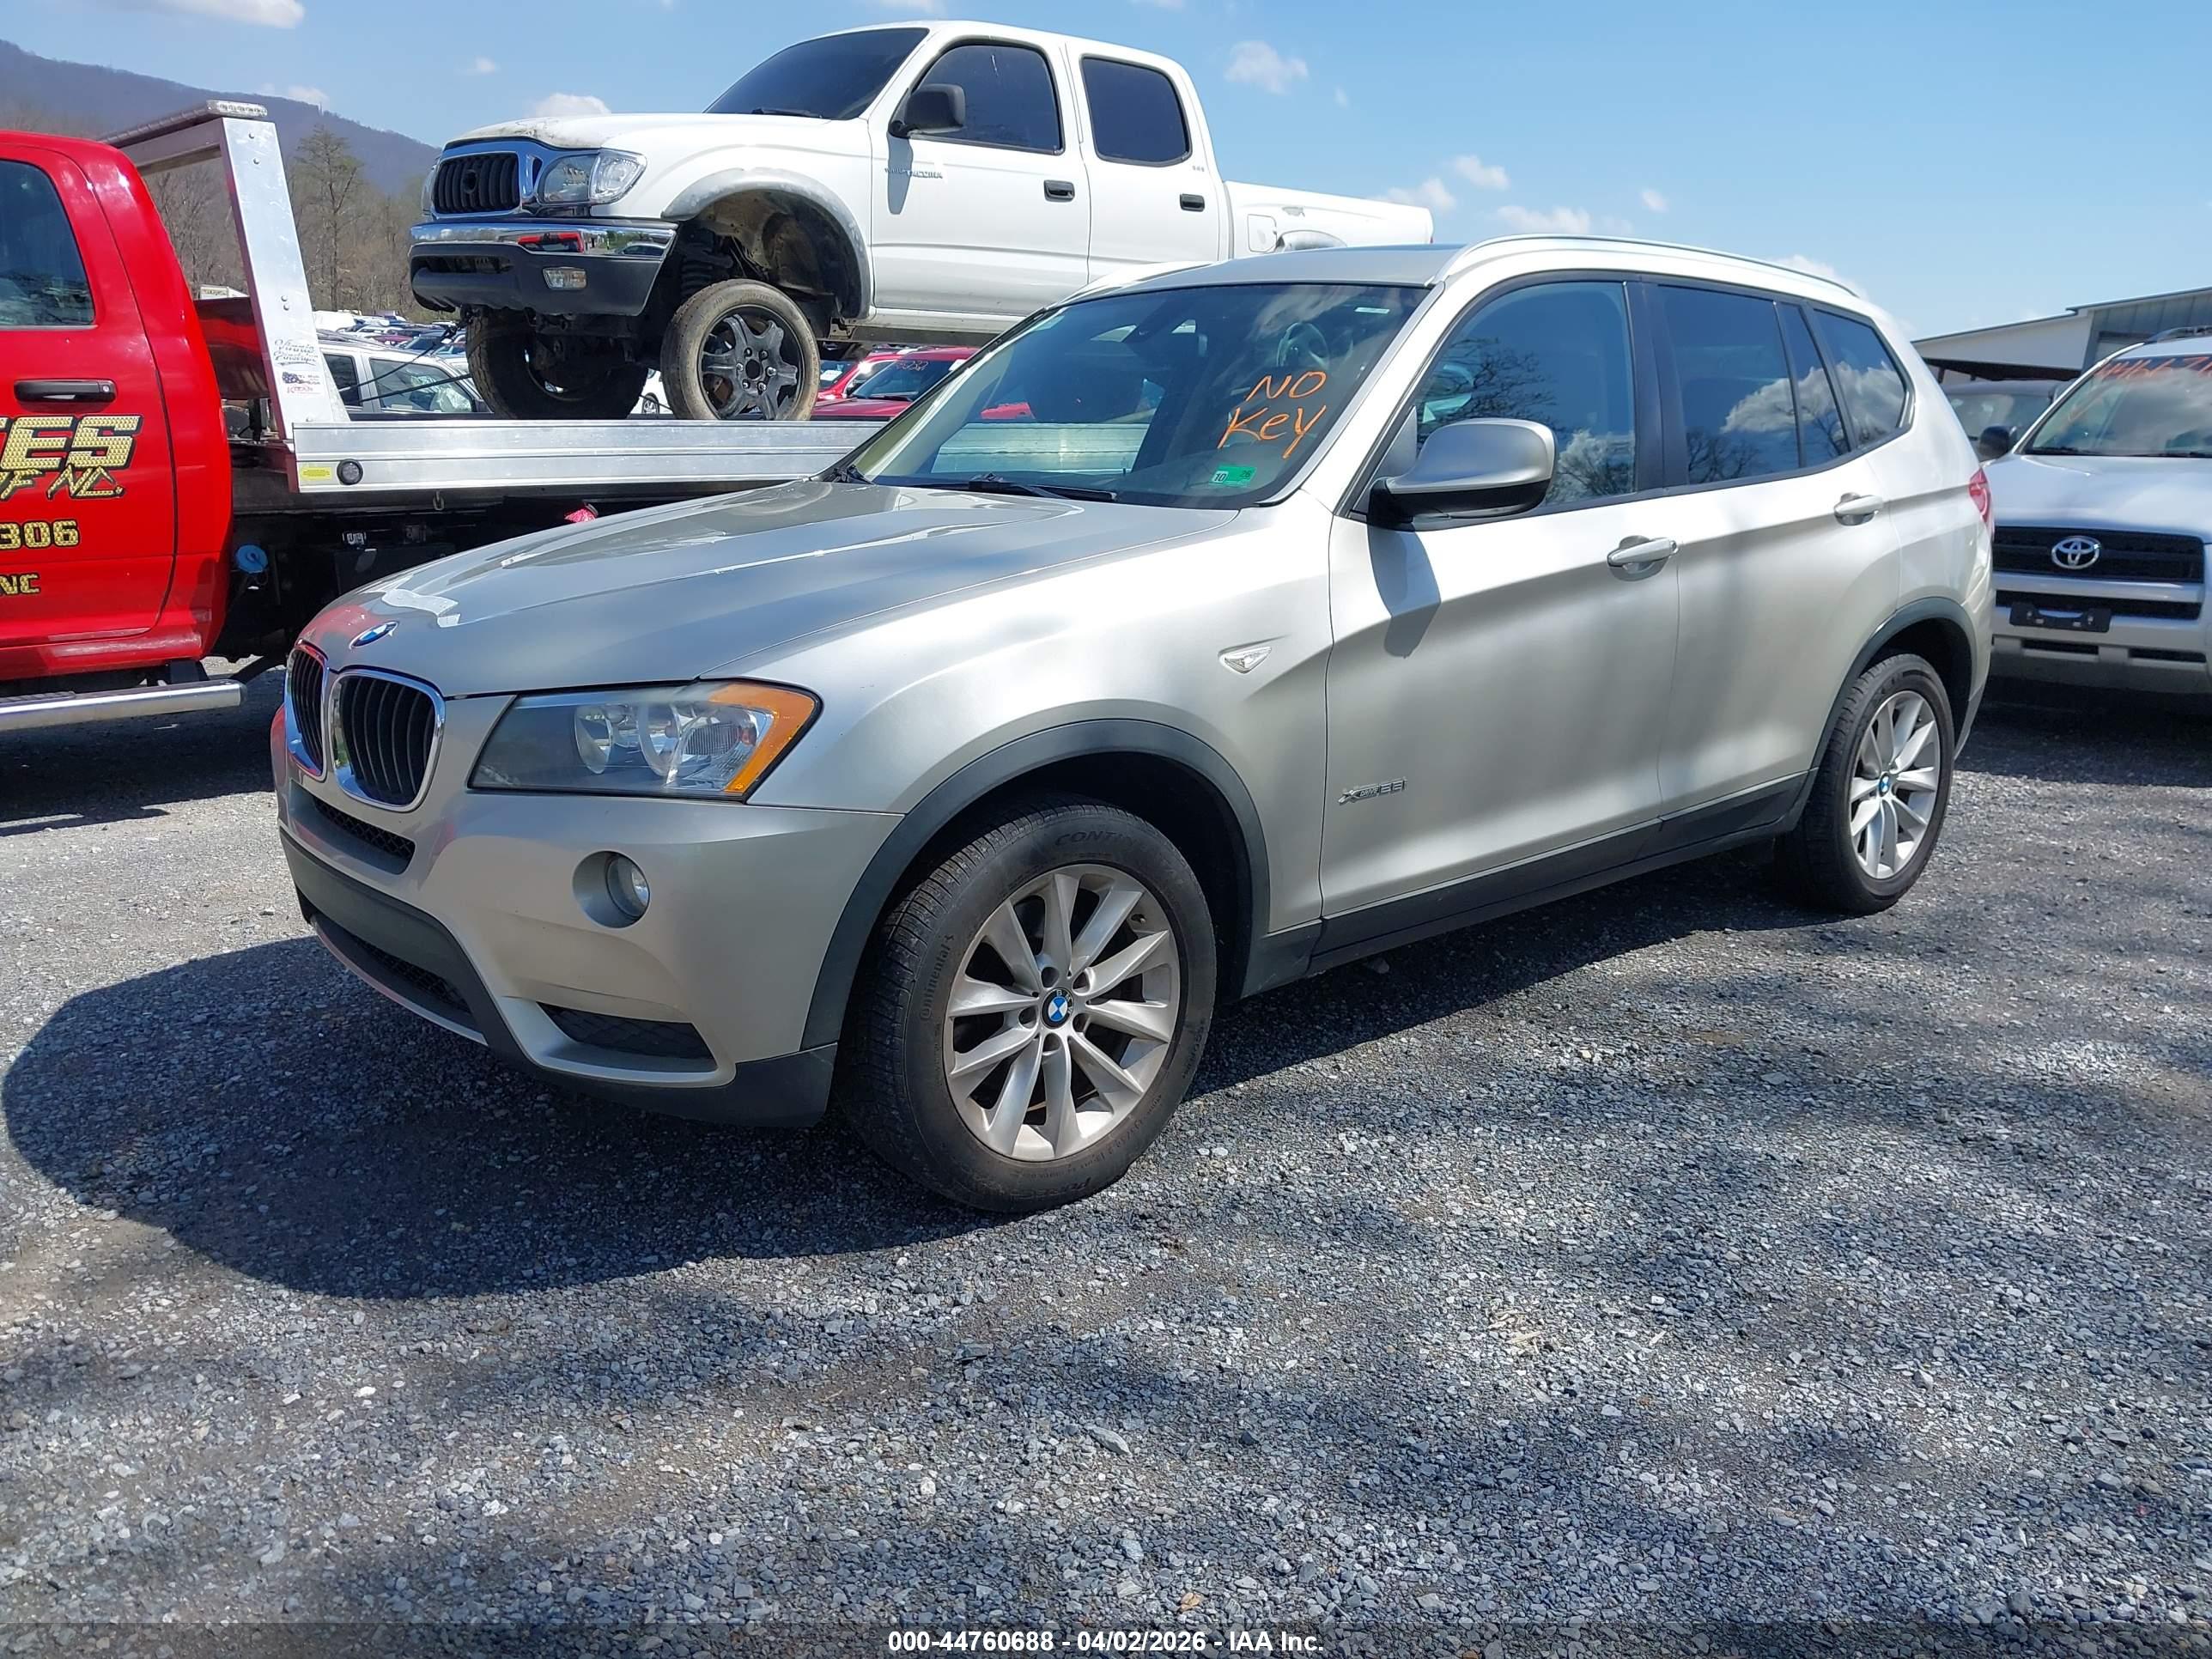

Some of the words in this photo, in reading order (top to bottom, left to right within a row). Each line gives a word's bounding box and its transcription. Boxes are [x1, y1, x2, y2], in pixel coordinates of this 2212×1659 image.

[1245, 370, 1327, 402] NO
[0, 415, 143, 469] ES
[1214, 472, 1227, 483] 10
